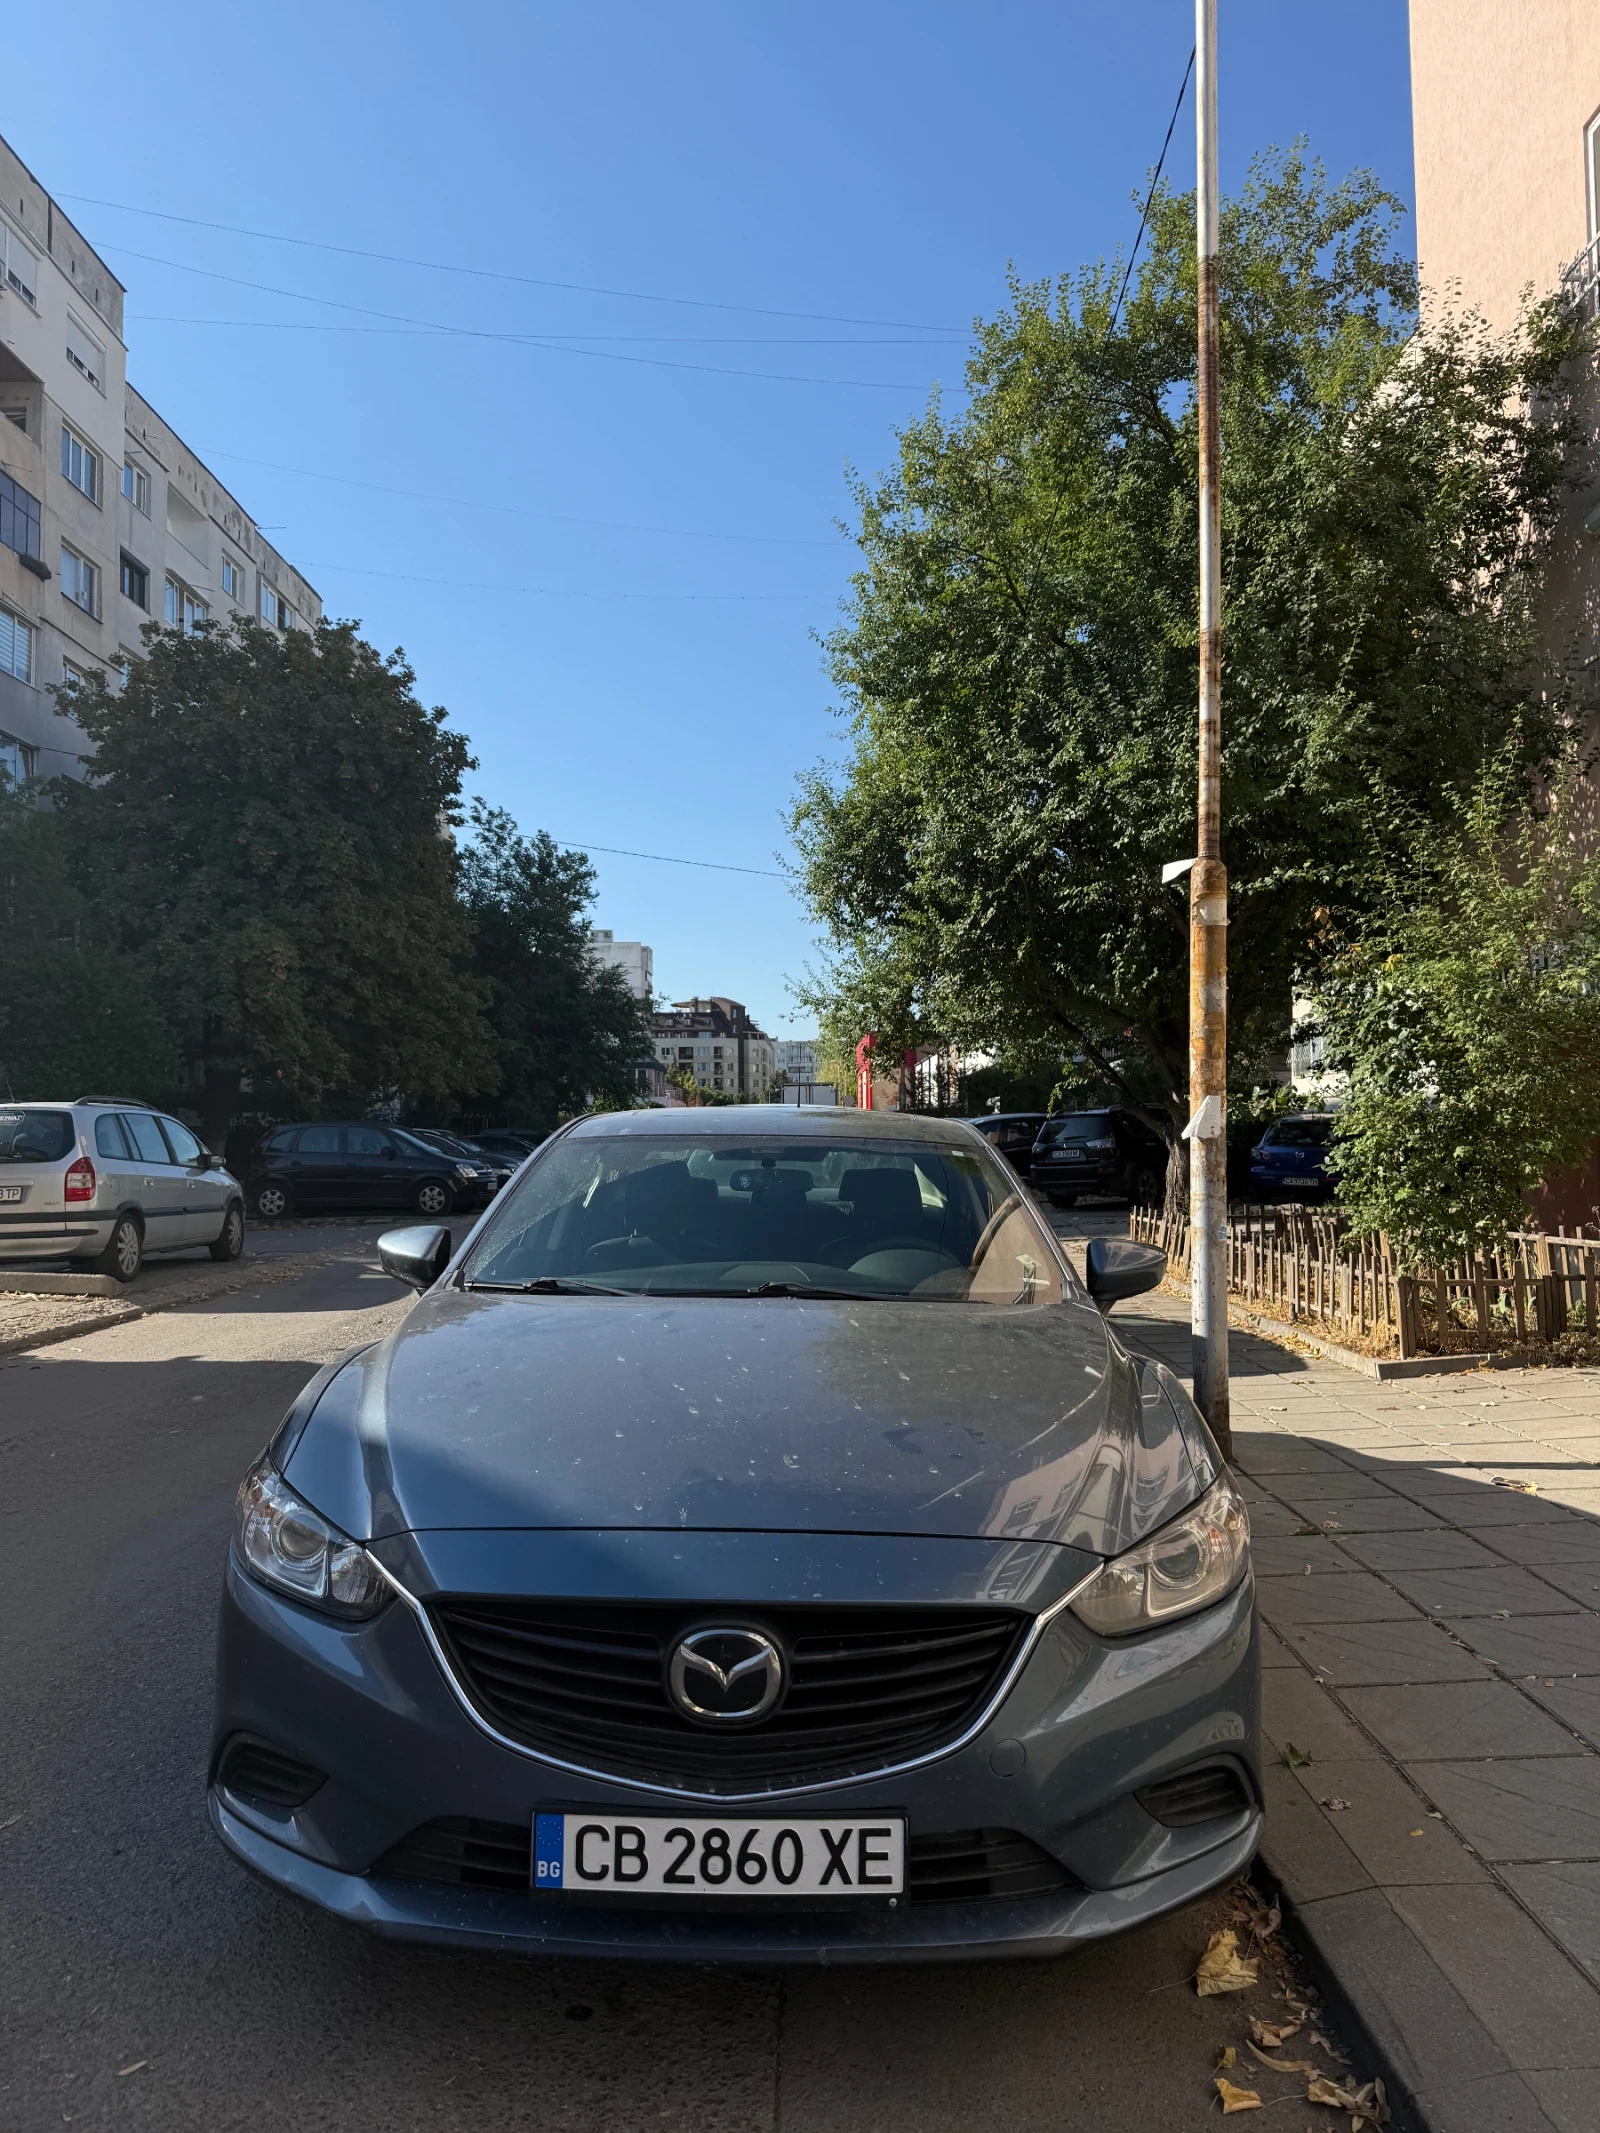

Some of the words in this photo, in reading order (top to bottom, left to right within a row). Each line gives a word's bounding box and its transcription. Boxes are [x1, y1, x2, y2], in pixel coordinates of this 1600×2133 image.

[6, 1188, 20, 1199] TP
[574, 1824, 649, 1883] CB
[663, 1827, 804, 1885] 2860
[819, 1828, 893, 1885] XE
[537, 1860, 560, 1879] BG
